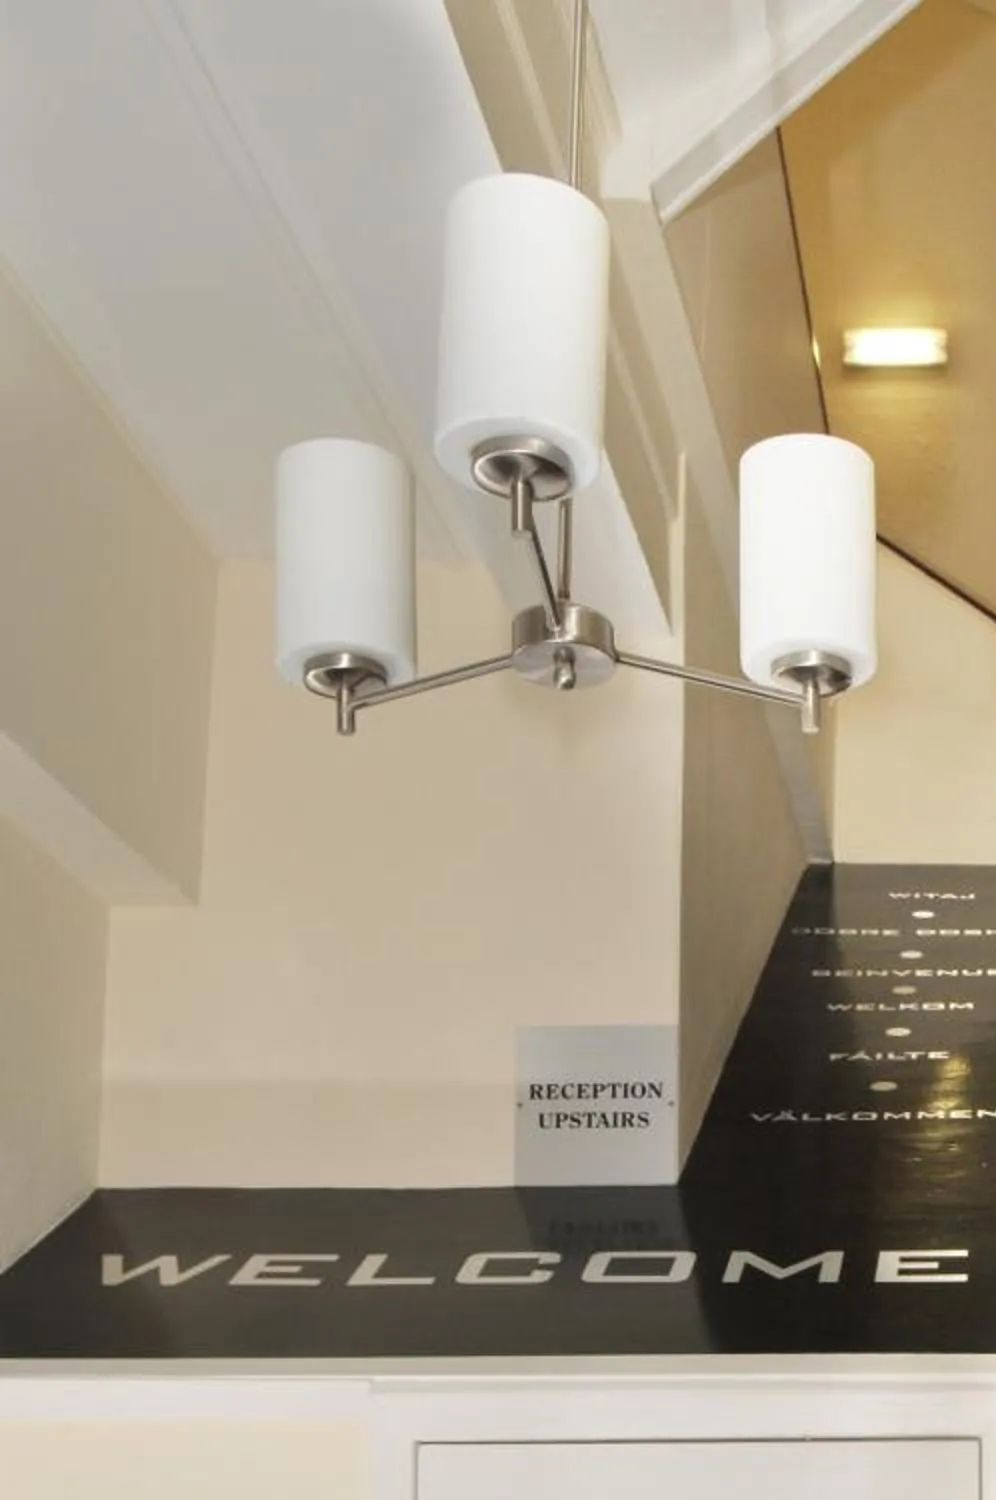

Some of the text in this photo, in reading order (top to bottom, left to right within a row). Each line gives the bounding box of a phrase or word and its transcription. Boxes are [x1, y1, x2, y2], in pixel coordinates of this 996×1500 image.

[827, 1002, 975, 1012] WELKOM
[529, 1082, 664, 1101] RECEPTION
[538, 1111, 651, 1129] UPSTAIRS
[100, 1249, 970, 1286] WELCOME
